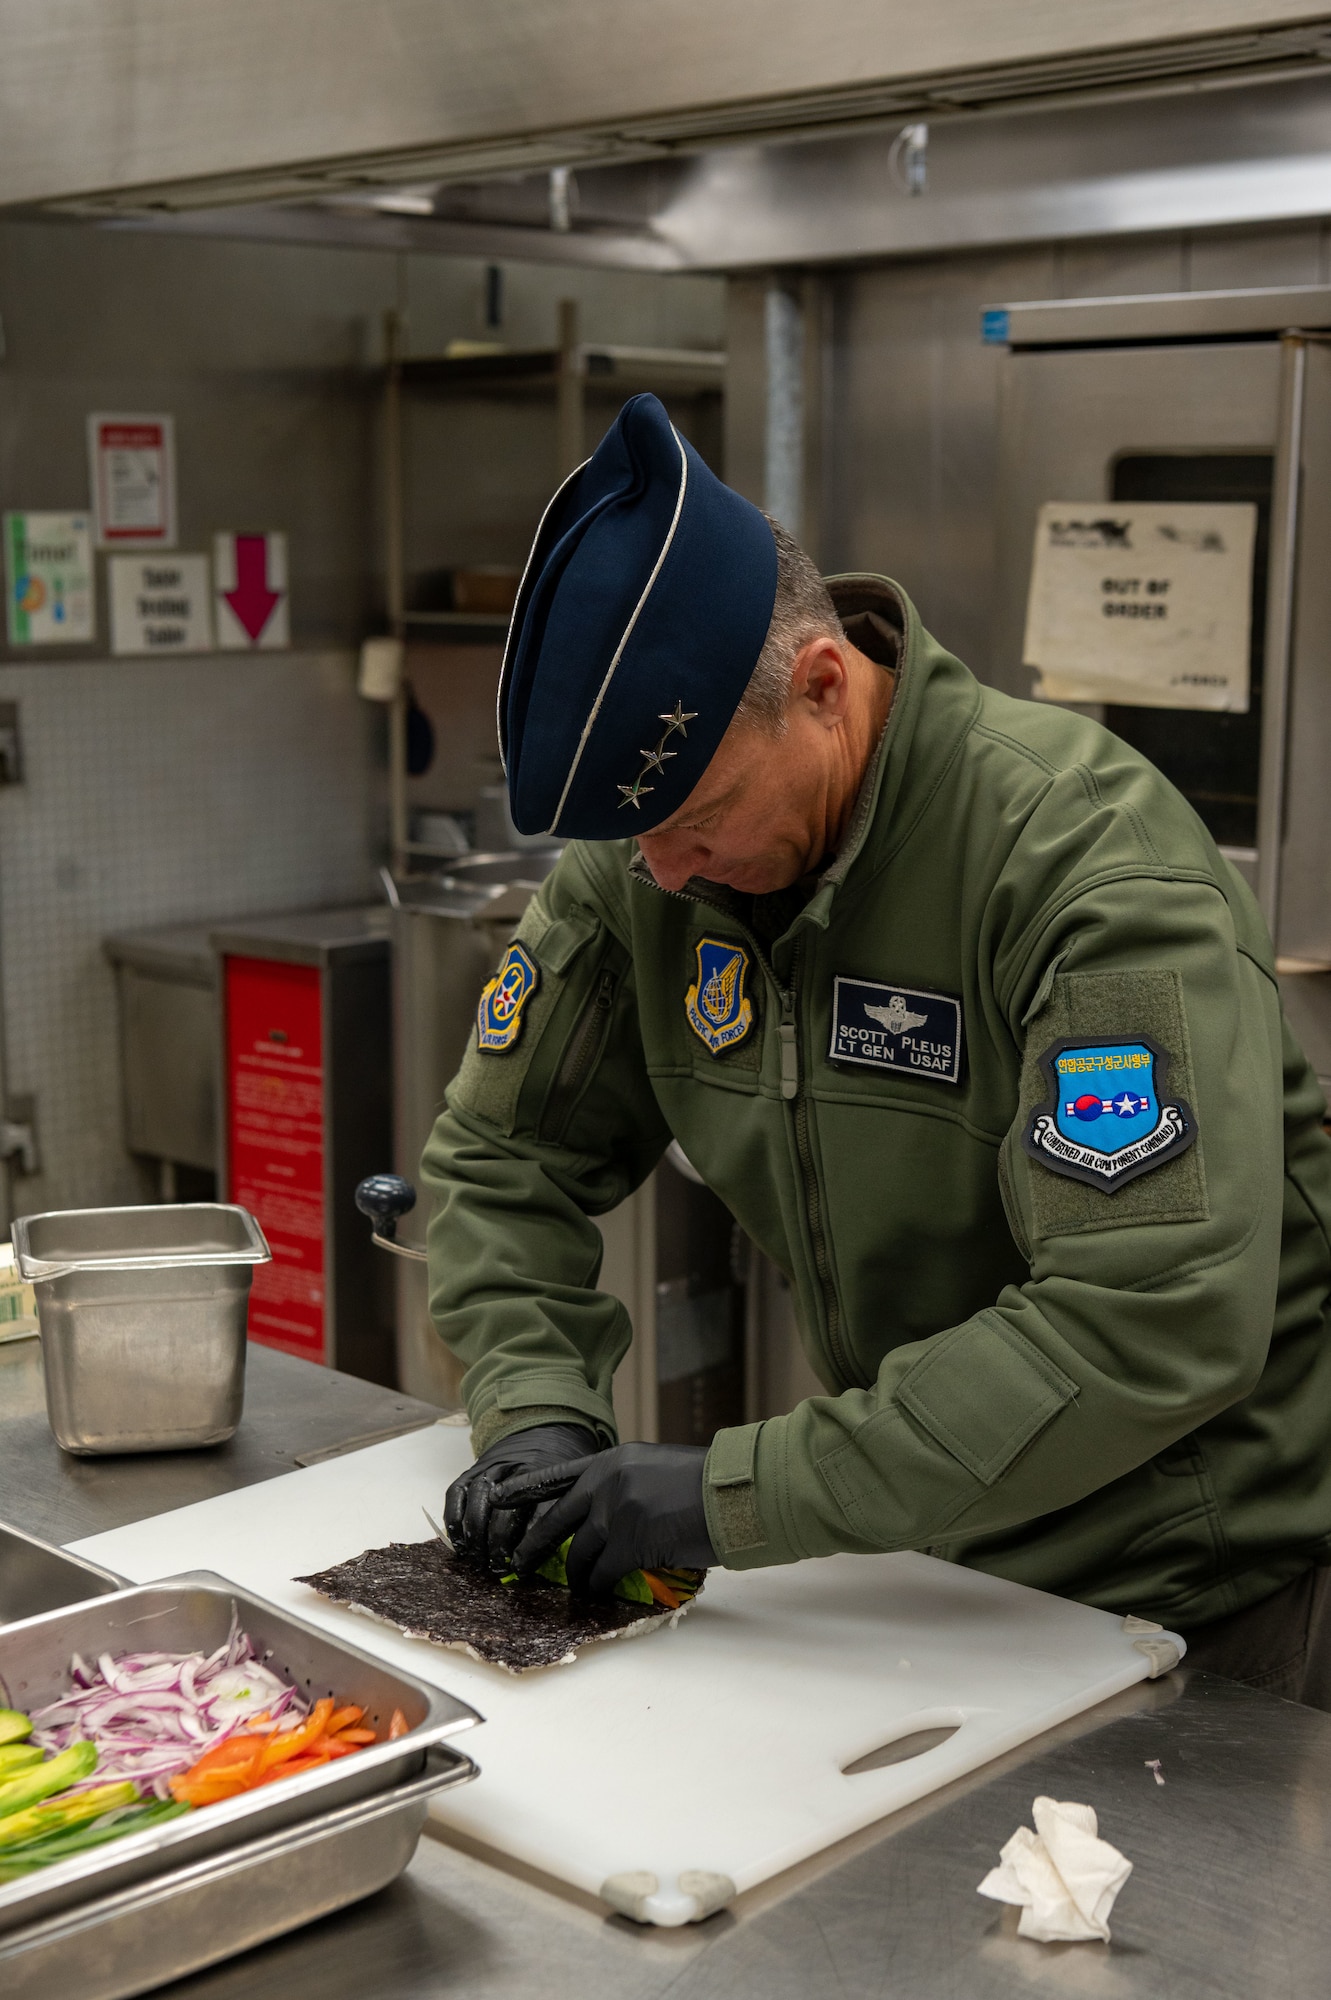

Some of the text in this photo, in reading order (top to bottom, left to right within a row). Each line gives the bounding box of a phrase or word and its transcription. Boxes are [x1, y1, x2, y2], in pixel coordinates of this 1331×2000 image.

[1101, 578, 1170, 595] OUT OF
[1102, 601, 1168, 619] ORDER
[493, 1034, 508, 1045] FORCE
[690, 1008, 745, 1048] PACIFIC AIR FORCES
[839, 1024, 952, 1058] SCOTT PLEUS
[837, 1038, 952, 1072] LT GEN USAF
[1043, 1131, 1081, 1160] COMBINED
[1080, 1152, 1095, 1167] AIR
[1140, 1124, 1175, 1154] COMMAND
